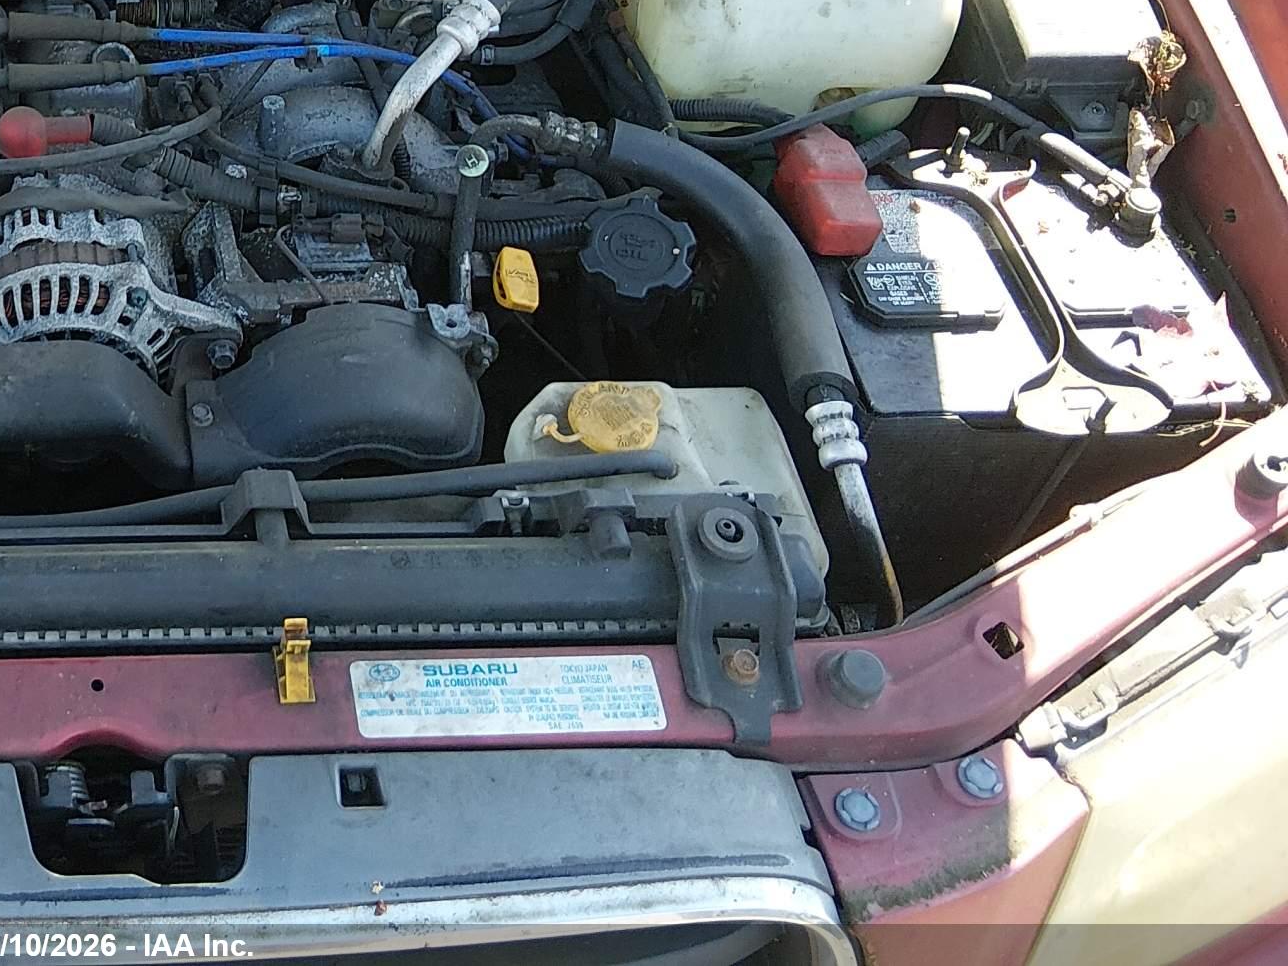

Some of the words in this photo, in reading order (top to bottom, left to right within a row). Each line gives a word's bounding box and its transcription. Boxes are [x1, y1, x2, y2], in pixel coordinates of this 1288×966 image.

[876, 262, 922, 271] DANGER
[422, 663, 518, 676] SUBARU
[560, 664, 584, 674] TOKYO
[585, 663, 608, 673] JAPAN
[632, 659, 645, 670] AE
[426, 678, 441, 688] AIR
[444, 676, 508, 688] CONDITIONER
[562, 674, 613, 684] CLIMATISEUR
